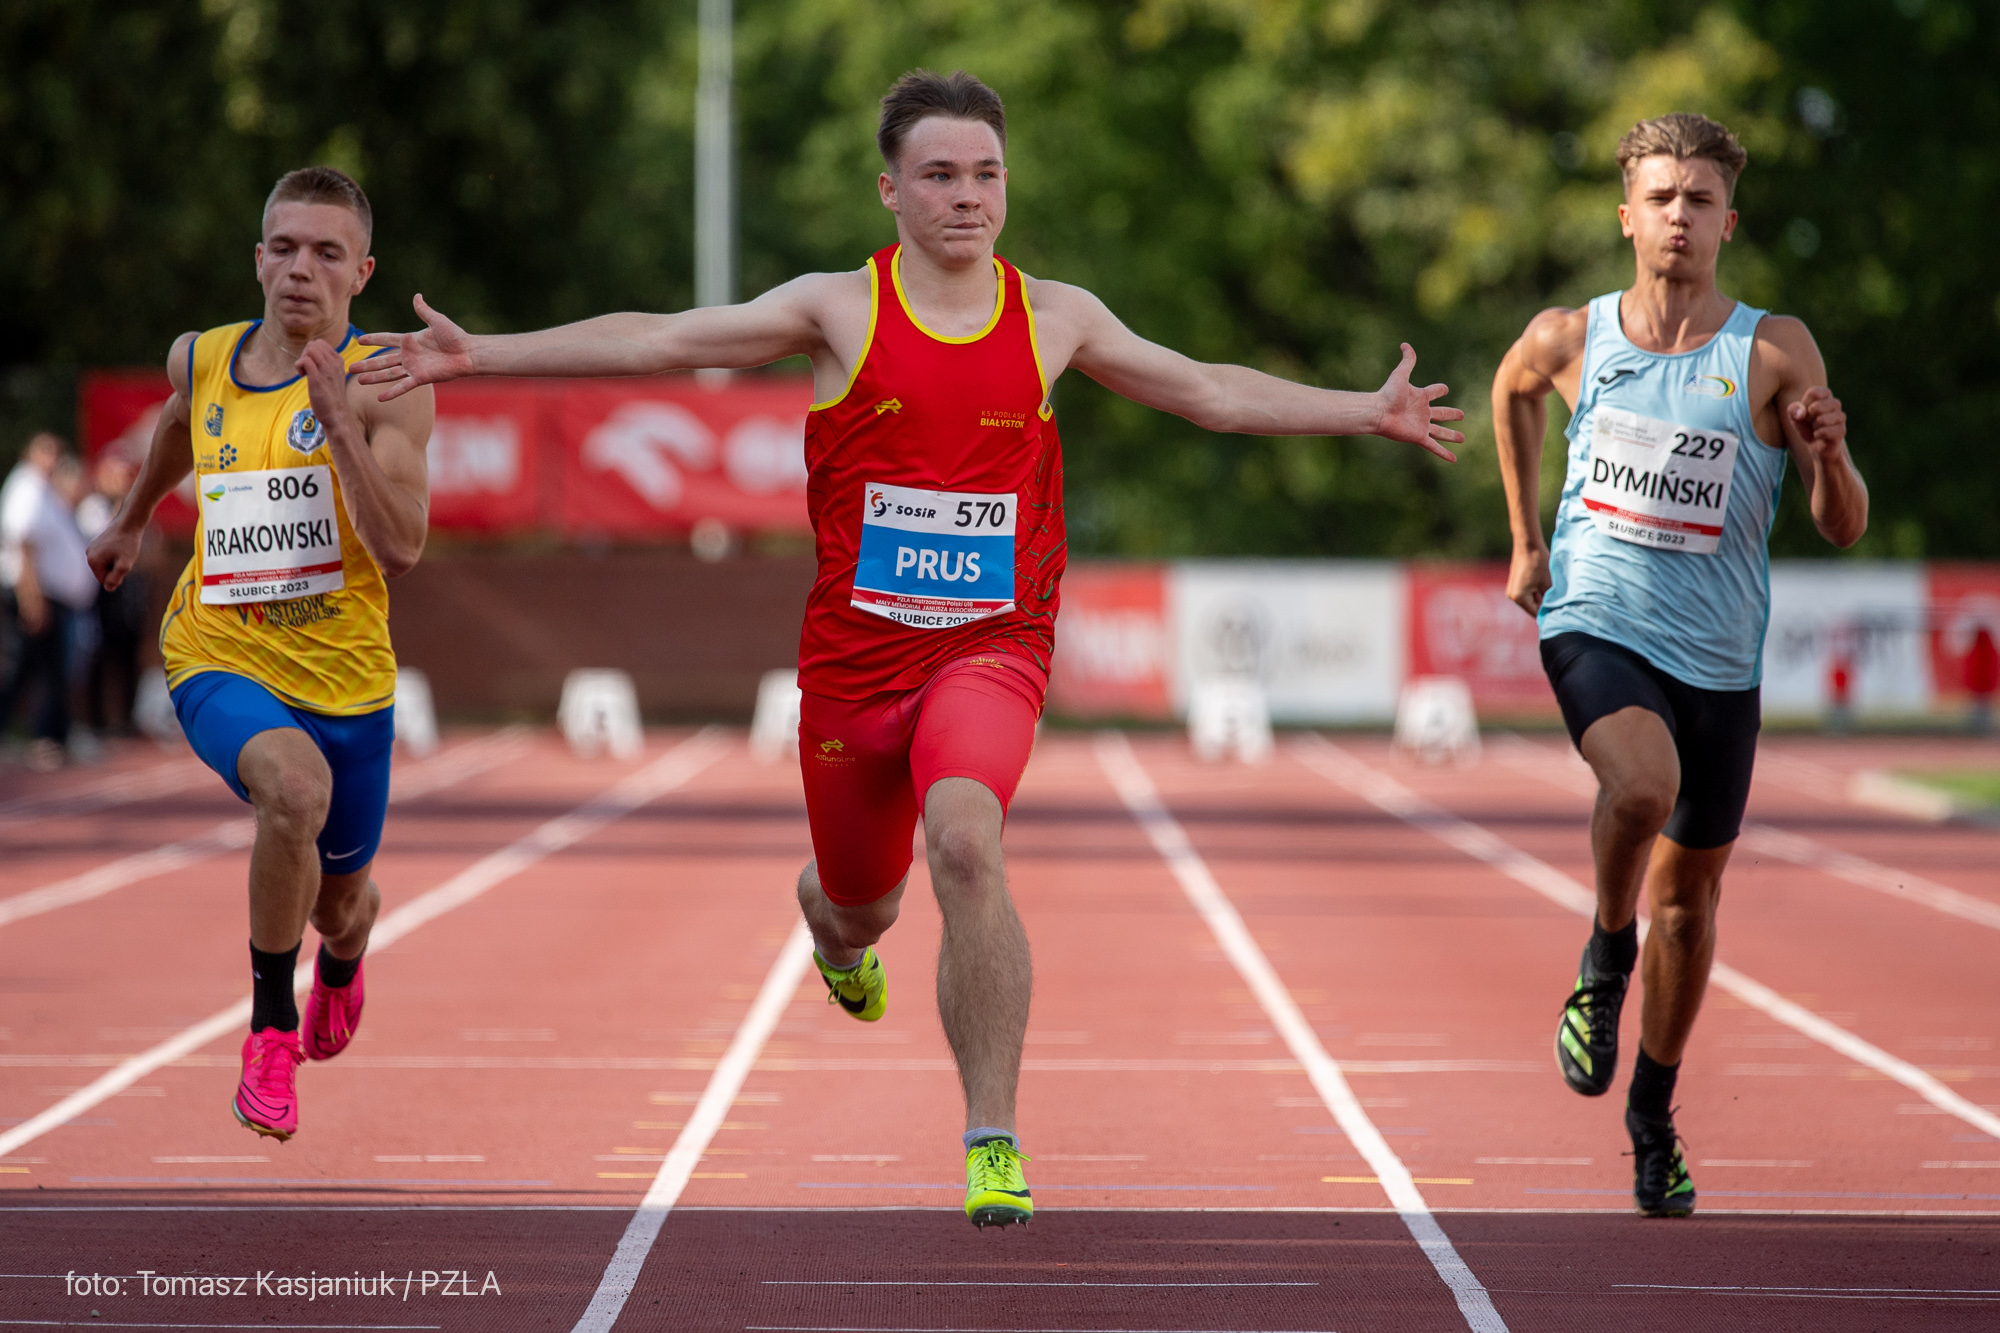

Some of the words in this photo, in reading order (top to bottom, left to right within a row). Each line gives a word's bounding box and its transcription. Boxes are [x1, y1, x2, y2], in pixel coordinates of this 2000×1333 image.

[980, 417, 1025, 429] BIAŁYSTOK
[993, 410, 1026, 420] PODLASIE
[1671, 432, 1725, 461] 229
[267, 473, 319, 501] 806
[1592, 457, 1723, 509] DYMIŃSKI
[954, 501, 1006, 528] 570
[207, 518, 333, 557] KRAKOWSKI
[1608, 521, 1655, 541] SŁUBICE
[1656, 533, 1686, 545] 2023
[895, 546, 982, 583] PRUS
[229, 585, 277, 597] SŁUBICE
[280, 580, 310, 594] 2023
[911, 598, 946, 606] Mistrzostwa
[922, 605, 948, 613] JANUSZA
[889, 611, 944, 626] SŁUBICE
